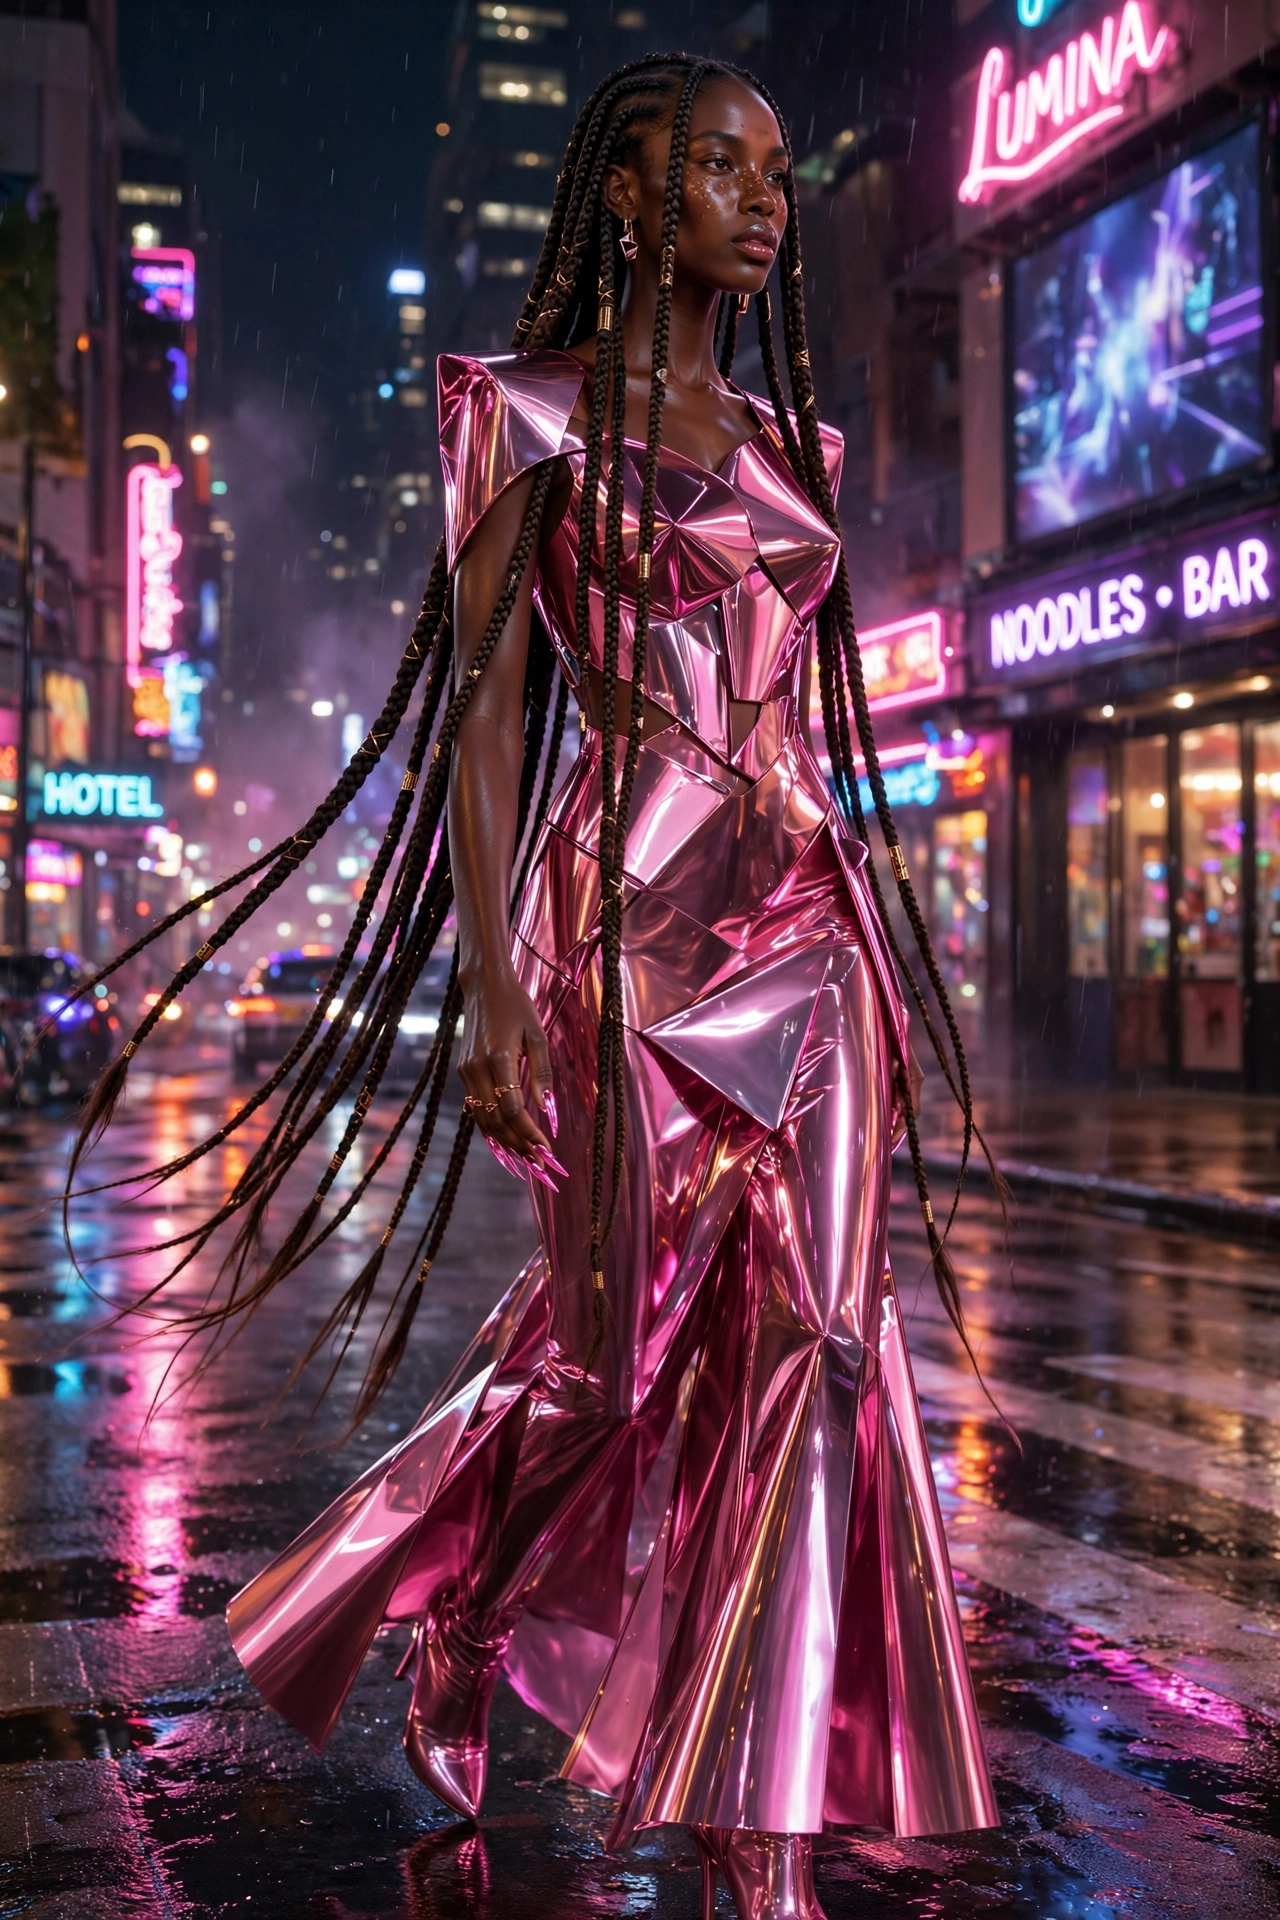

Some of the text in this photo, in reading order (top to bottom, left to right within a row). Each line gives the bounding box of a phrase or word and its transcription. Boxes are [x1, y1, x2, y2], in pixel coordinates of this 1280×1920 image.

[958, 0, 1170, 203] LUMINA
[990, 573, 1147, 669] NOODLES
[1182, 538, 1271, 620] BAR
[43, 771, 165, 818] HOTEL
